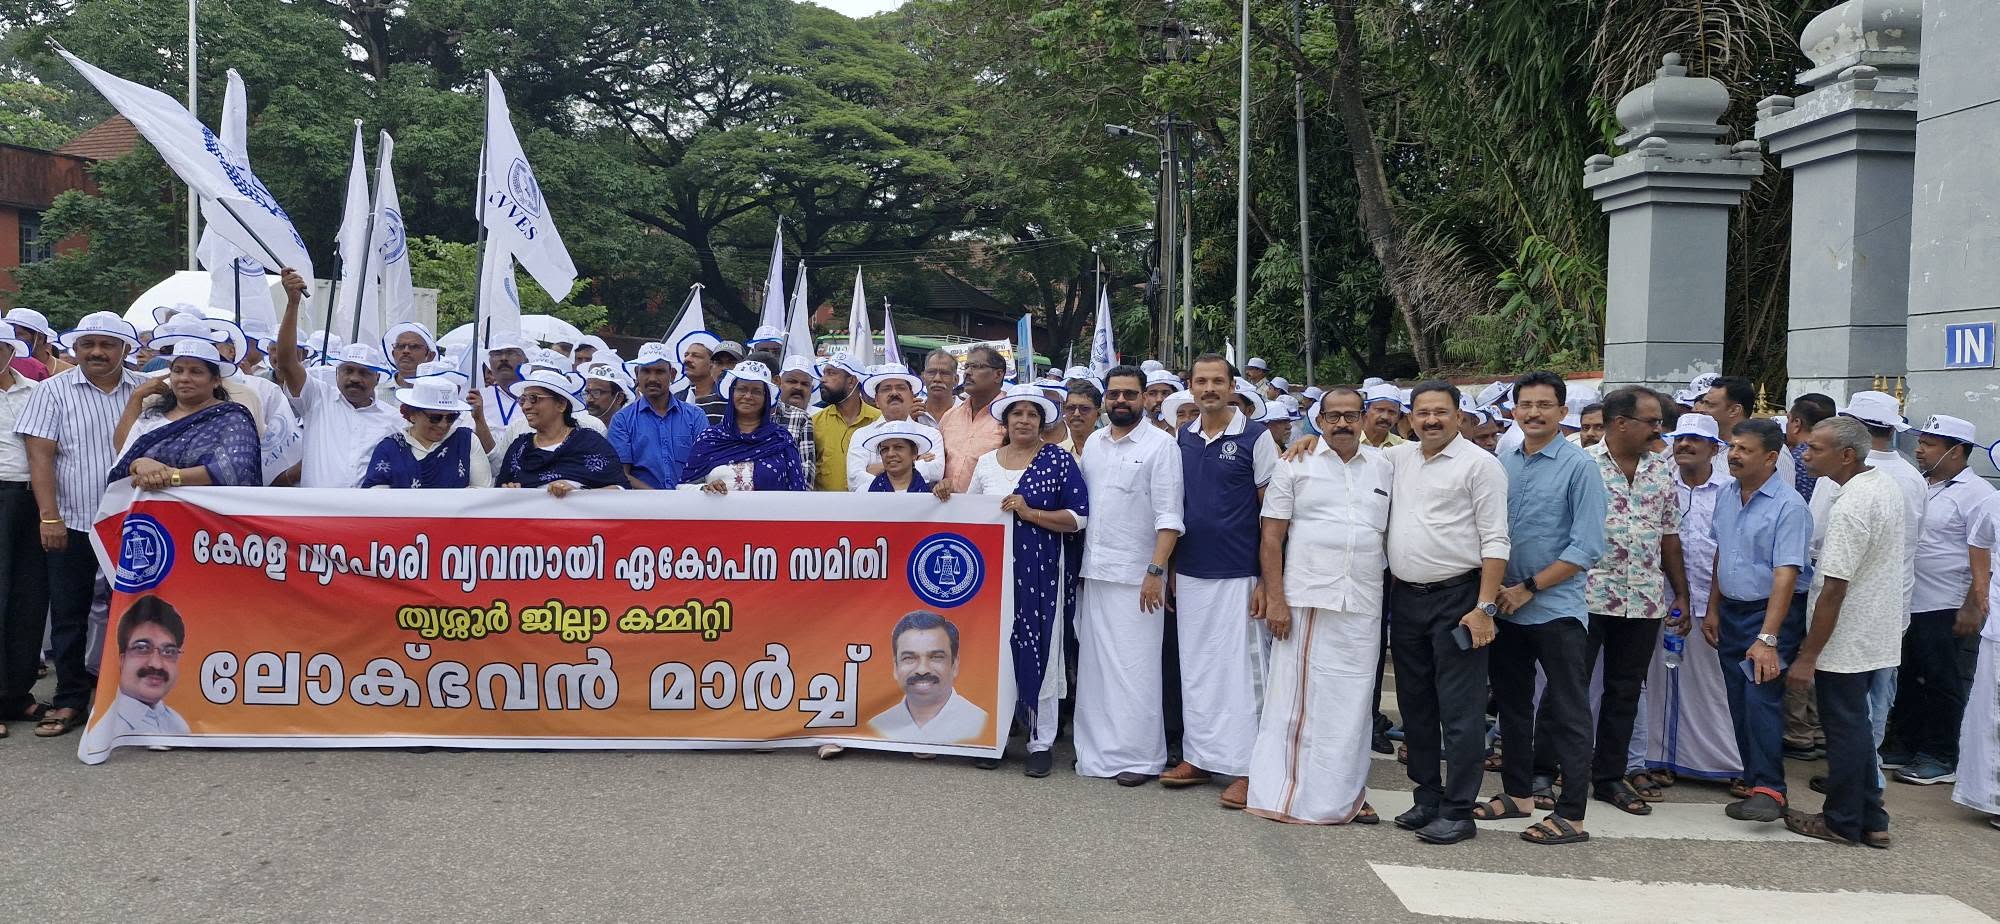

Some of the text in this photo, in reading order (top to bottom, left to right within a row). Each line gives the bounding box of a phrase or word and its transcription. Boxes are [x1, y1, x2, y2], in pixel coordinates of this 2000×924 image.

[1955, 327, 1985, 363] IN
[194, 530, 888, 592] കേരള വ്യാപാരി വ്യവസായി ഏകോപന സമിതി
[398, 599, 732, 642] തൃശ്ശൂർ ജില്ലാ കമ്മിറ്റി
[200, 643, 872, 728] ലോക്ഭവൻ മാർച്ച്
